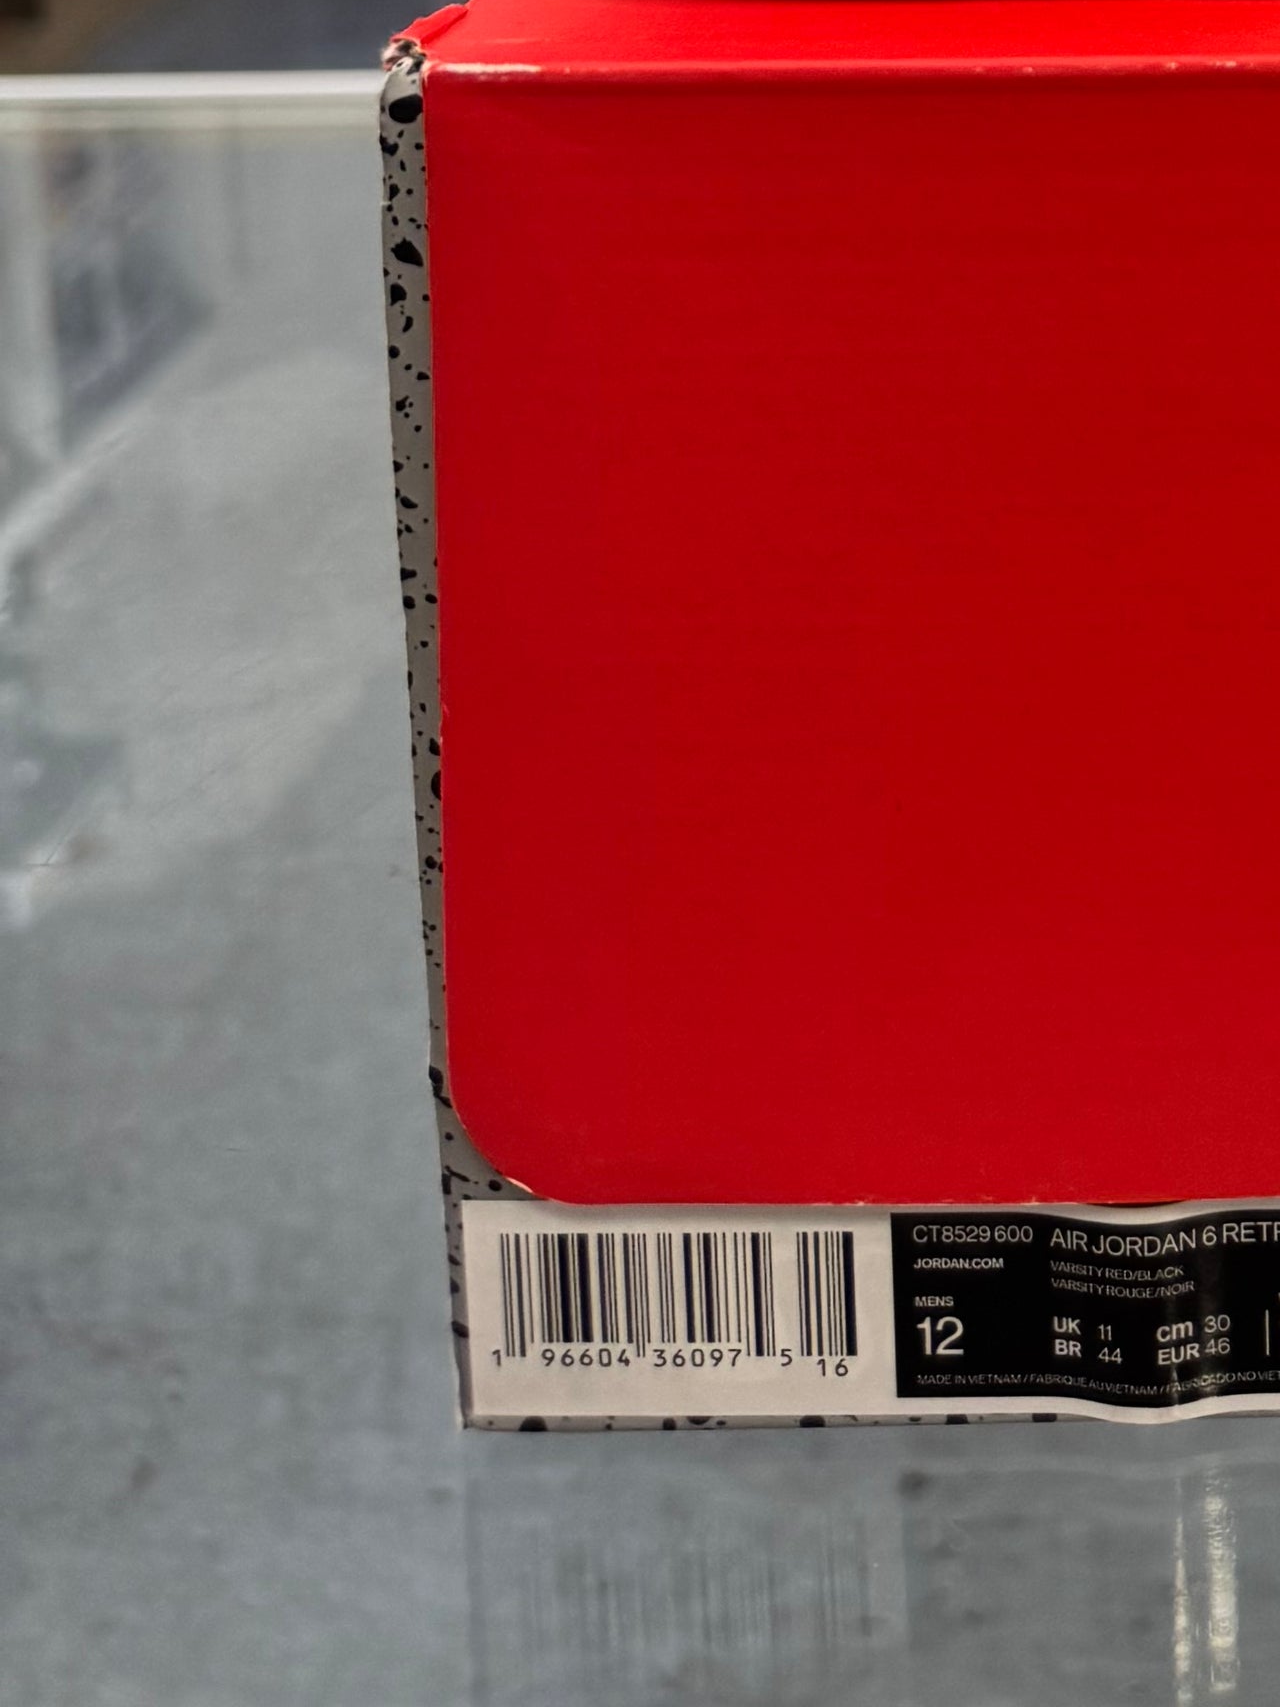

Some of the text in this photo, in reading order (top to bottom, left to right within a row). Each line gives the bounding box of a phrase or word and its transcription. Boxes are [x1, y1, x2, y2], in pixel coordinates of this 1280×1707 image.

[913, 1225, 1033, 1243] CT8529 600
[1050, 1228, 1088, 1252] AIR
[1092, 1228, 1197, 1257] JORDAN
[1202, 1225, 1217, 1246] 6
[913, 1258, 1004, 1269] JORDAN.COM
[1050, 1260, 1185, 1281] VARSITY RED/BLACK
[1051, 1278, 1195, 1299] VARSITY ROUGE/NOIR
[915, 1296, 954, 1307] MENS
[916, 1316, 964, 1355] 12
[1053, 1316, 1113, 1341] UK 11
[1156, 1314, 1231, 1342] cm 30
[491, 1349, 849, 1377] 1 96604 36097 5 16
[1054, 1339, 1123, 1365] BR 44
[1158, 1337, 1231, 1365] EUR 46
[917, 1374, 952, 1385] MADE
[954, 1374, 966, 1385] IN
[968, 1373, 1022, 1385] VIETNAM
